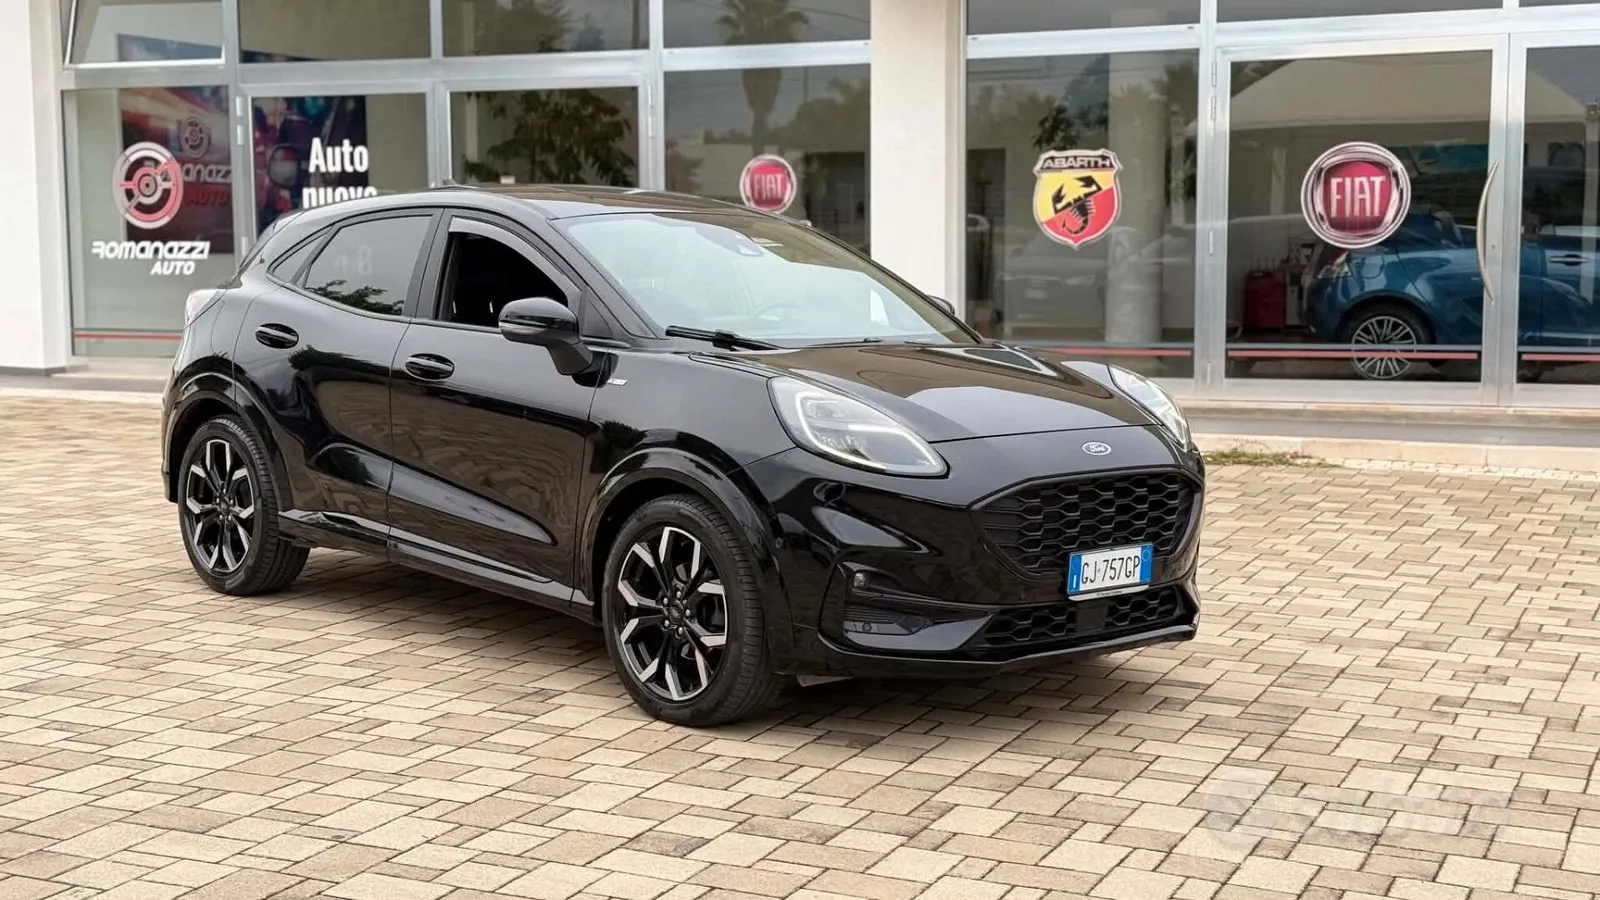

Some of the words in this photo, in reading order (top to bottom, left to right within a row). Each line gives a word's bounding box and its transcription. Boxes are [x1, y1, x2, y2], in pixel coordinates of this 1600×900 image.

[308, 137, 369, 173] Auto
[1043, 156, 1111, 169] ABARTH
[753, 173, 784, 201] FIAT
[1330, 175, 1386, 218] FIAT
[150, 261, 196, 275] AUTO
